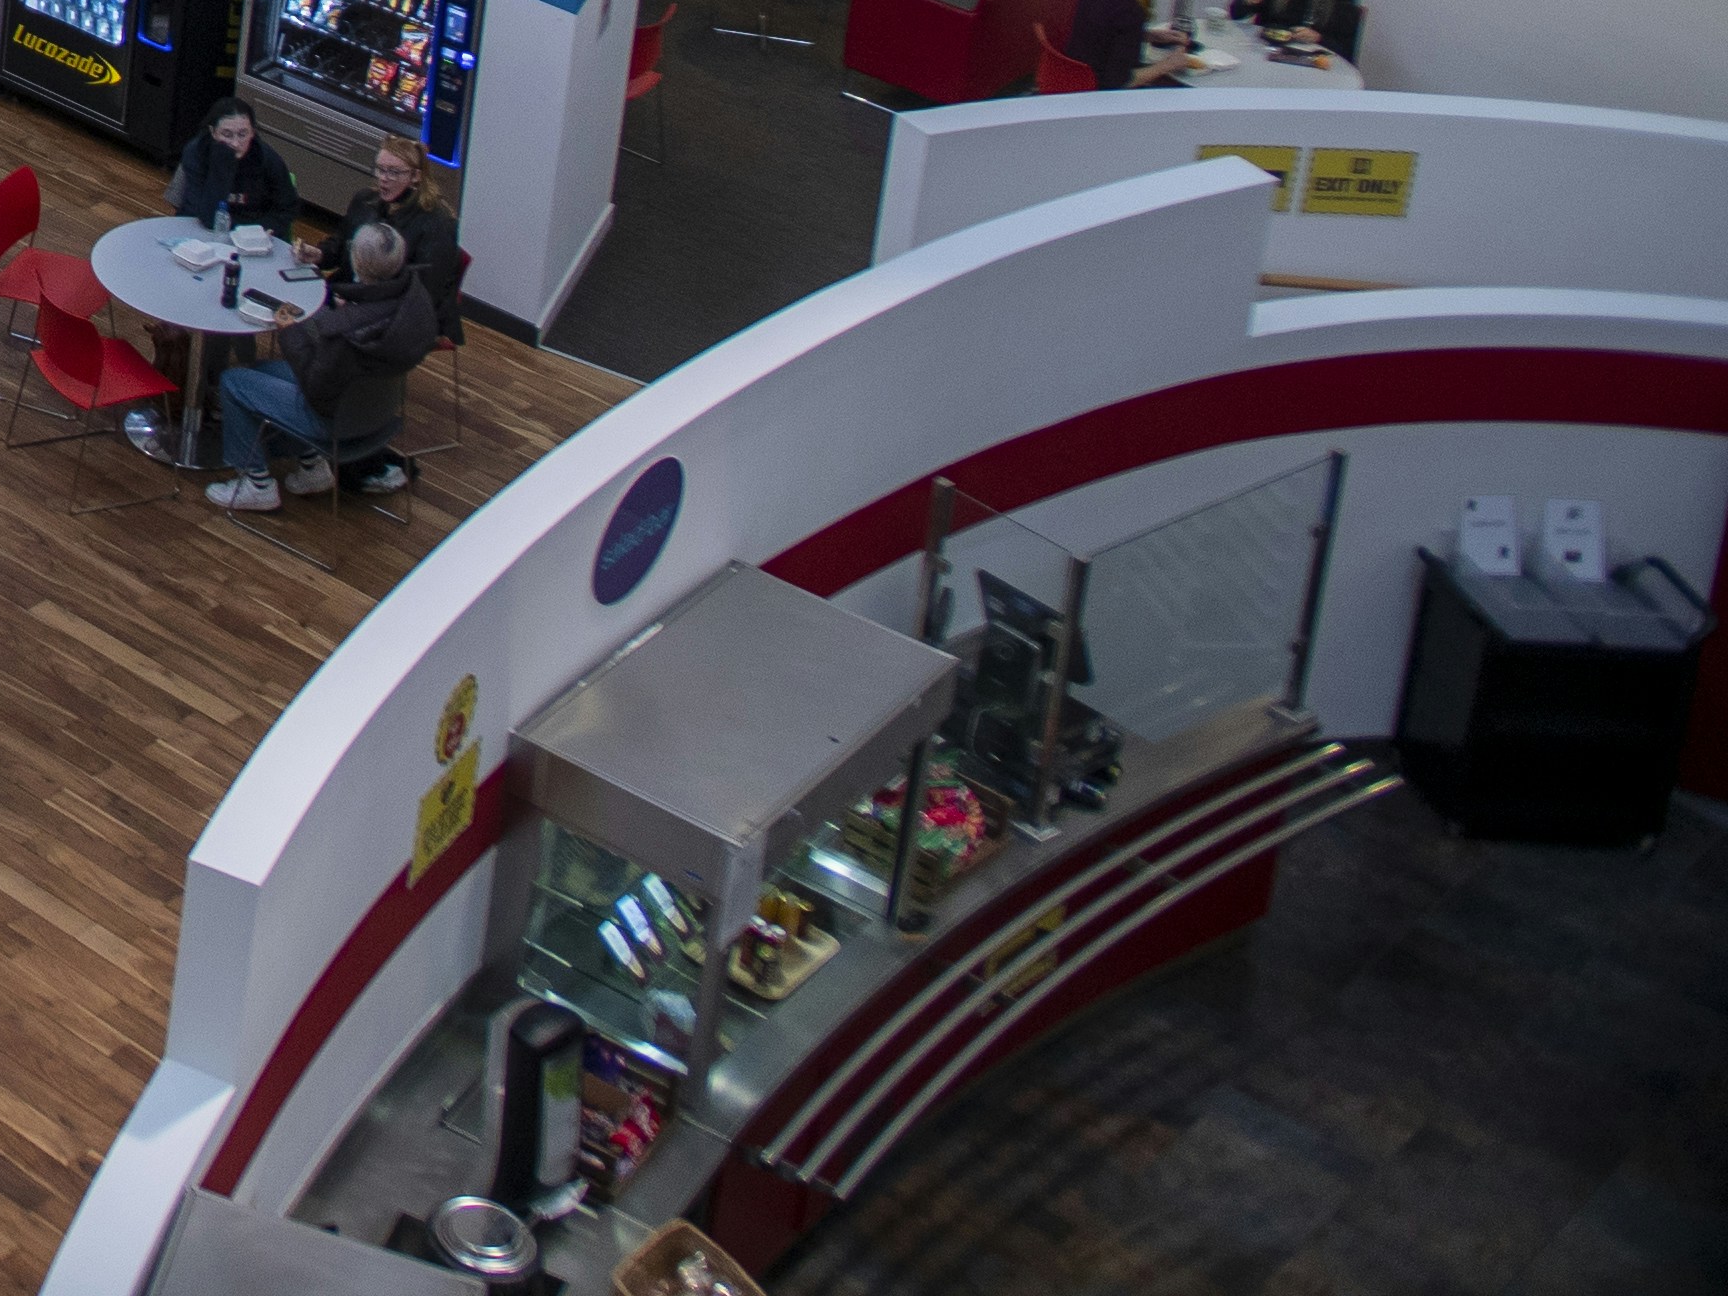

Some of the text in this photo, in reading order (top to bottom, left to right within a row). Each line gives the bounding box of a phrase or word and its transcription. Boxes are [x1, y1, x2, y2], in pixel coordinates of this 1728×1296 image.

[13, 23, 104, 79] Lucozade
[1313, 177, 1403, 195] EXIT ONLY
